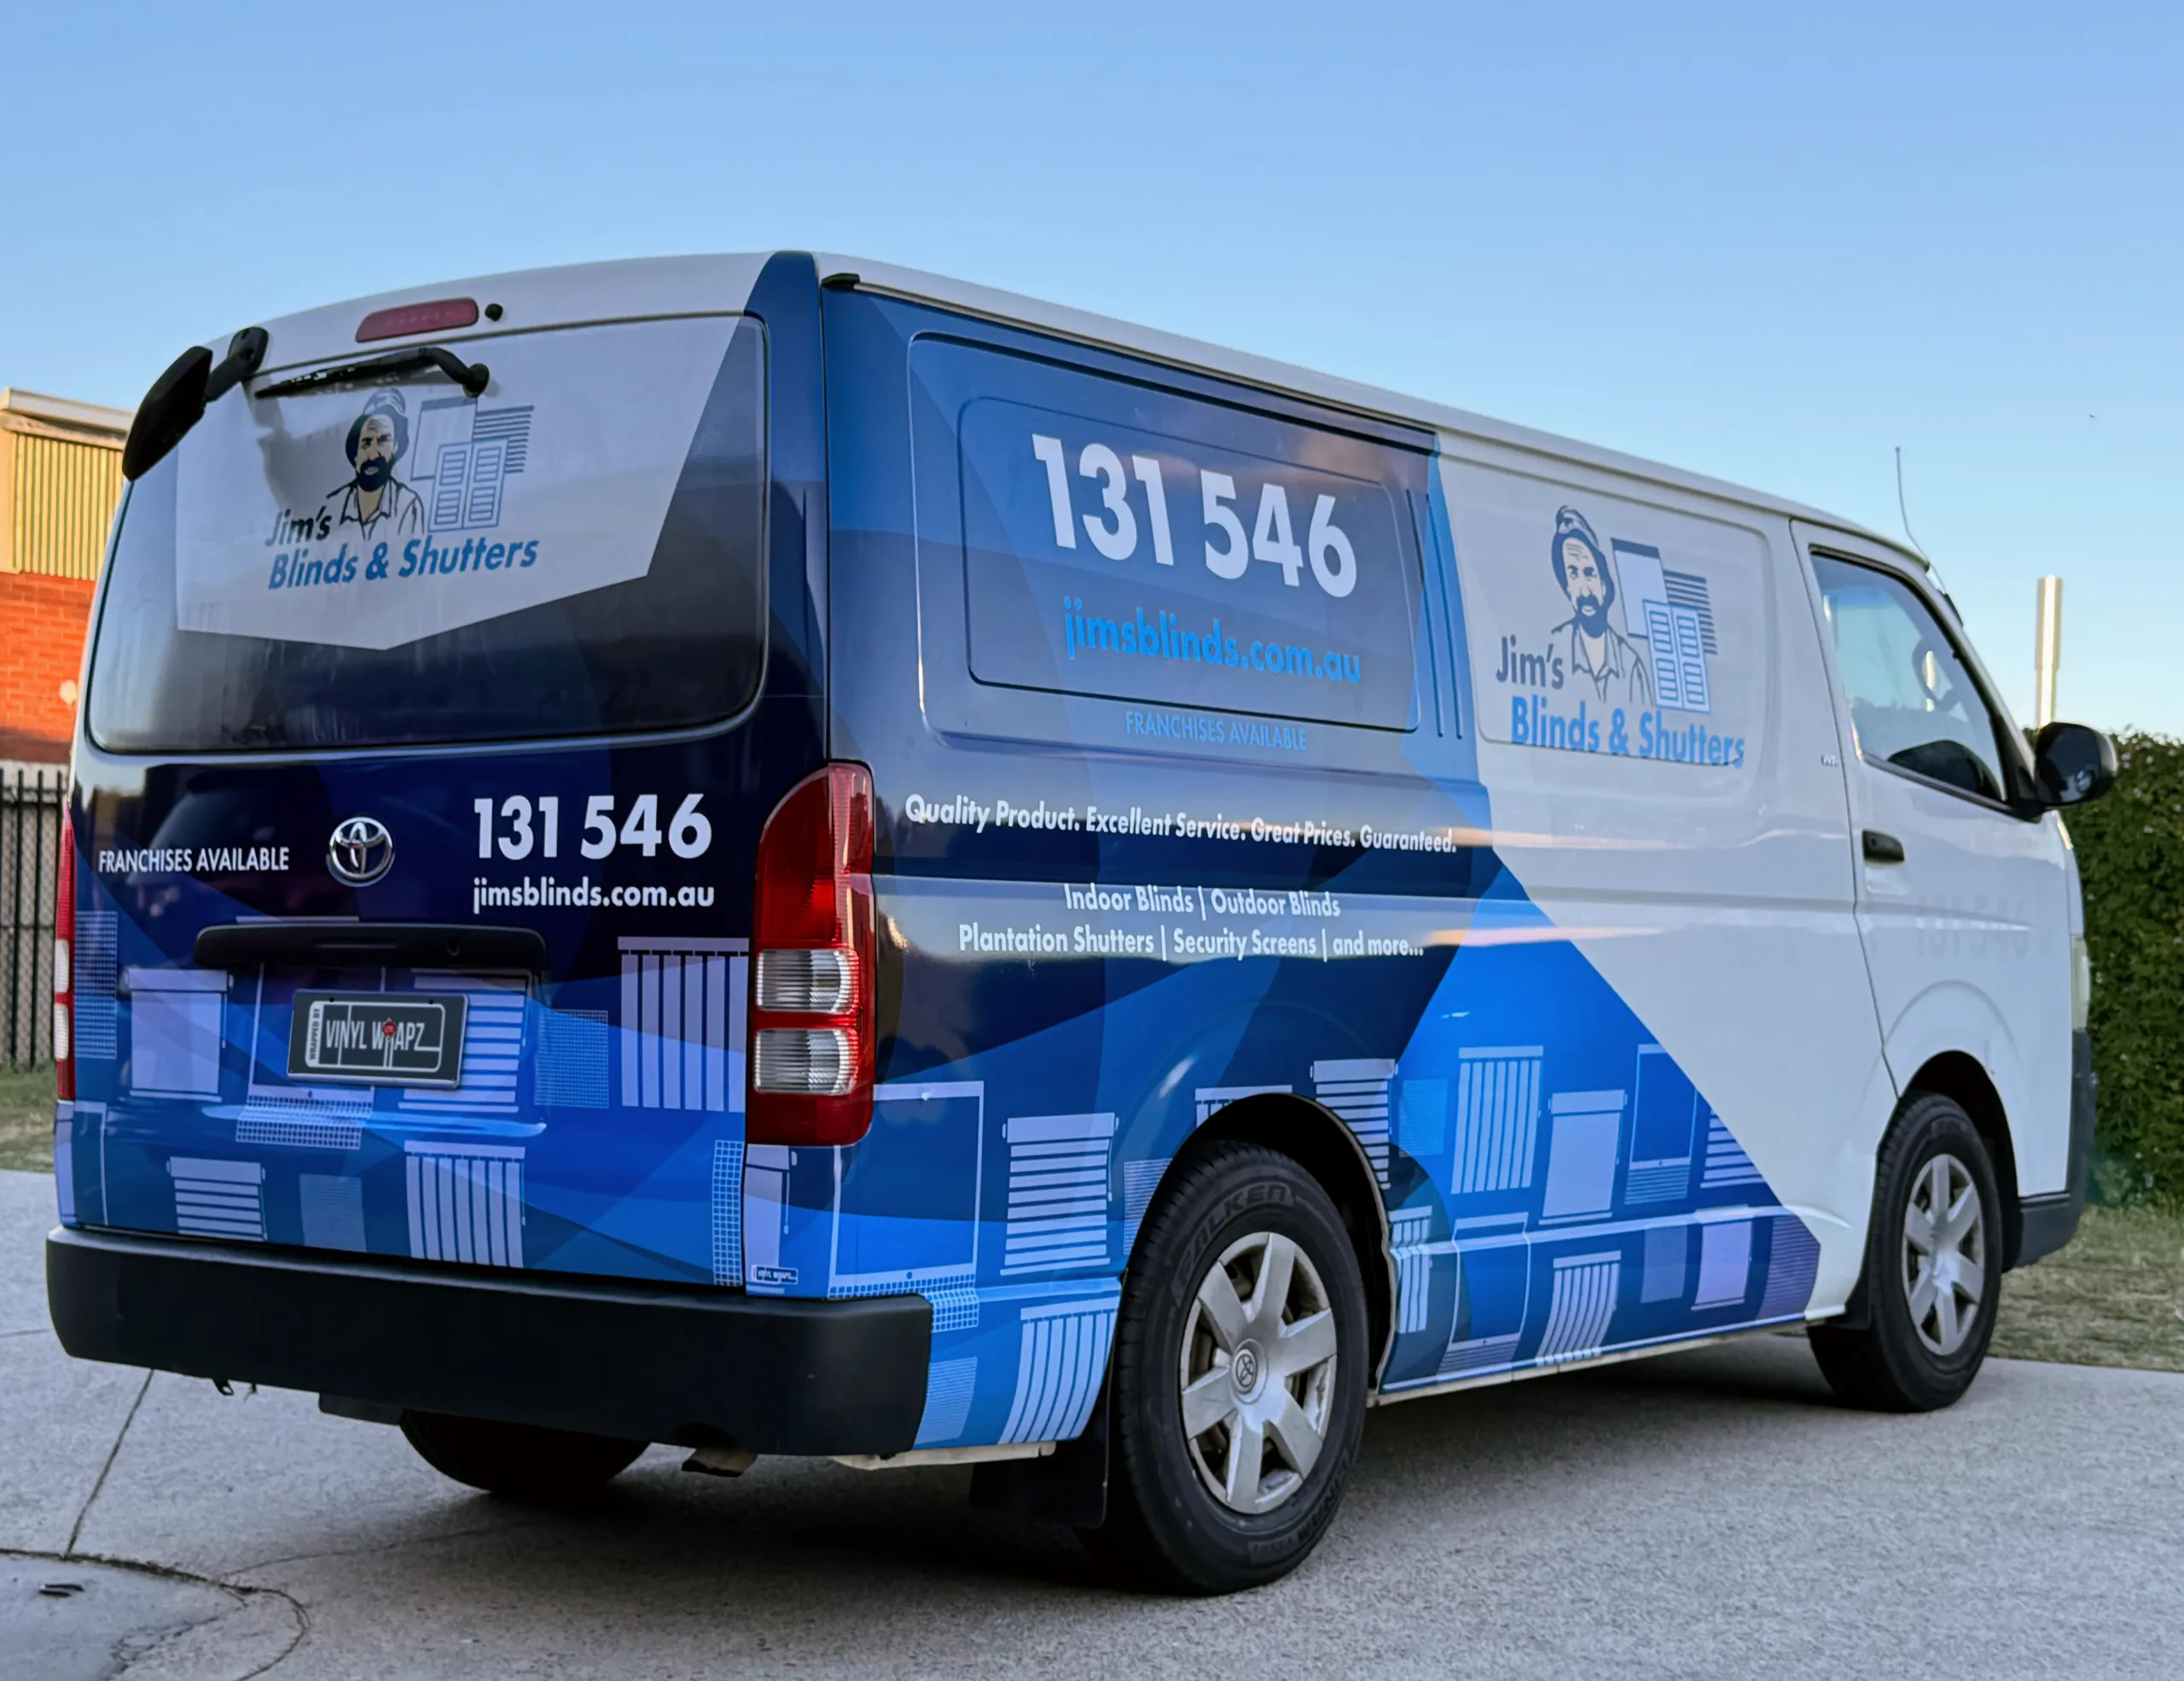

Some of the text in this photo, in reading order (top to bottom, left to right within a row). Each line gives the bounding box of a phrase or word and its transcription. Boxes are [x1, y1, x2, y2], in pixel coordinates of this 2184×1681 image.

[264, 505, 332, 547] Jim's
[1031, 433, 1357, 597] 131 546
[268, 535, 540, 590] Blinds & Shutters
[1063, 596, 1362, 683] jimsblinds.com.au
[1496, 635, 1565, 689] Jim's
[1126, 711, 1307, 751] FRANCHISES AVAILABLE
[1512, 694, 1745, 768] Blinds & Shutters
[474, 794, 712, 860] 131 546
[905, 794, 1457, 853] Quality Product. Excellent Service. Great Prices. Guaranteed.
[99, 846, 289, 873] FRANCHISES AVAILABLE
[473, 876, 714, 914] jimsblinds.com.au
[1064, 882, 1131, 910] Indoor
[1135, 884, 1194, 912] Blinds
[1211, 888, 1286, 916] Outdoor
[1288, 891, 1341, 917] Blinds
[959, 922, 1067, 952] Plantation
[1073, 924, 1154, 953] Shutters
[1173, 927, 1246, 961] Security
[1252, 928, 1316, 955] Screens
[1333, 930, 1364, 955] and
[1368, 939, 1424, 957] more...
[326, 1020, 367, 1049] VINYL
